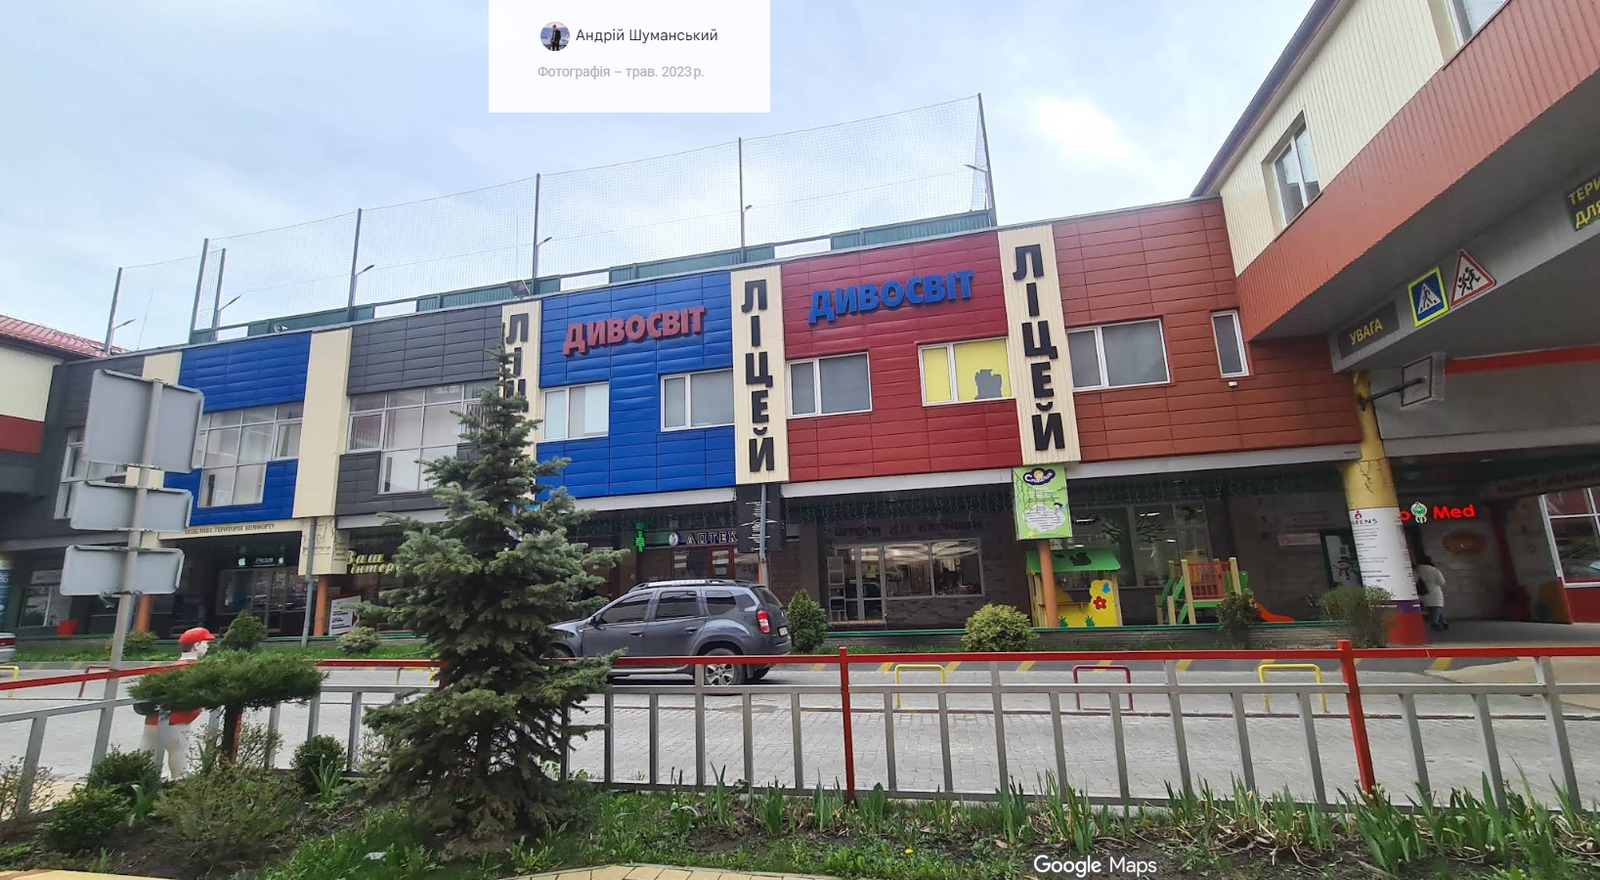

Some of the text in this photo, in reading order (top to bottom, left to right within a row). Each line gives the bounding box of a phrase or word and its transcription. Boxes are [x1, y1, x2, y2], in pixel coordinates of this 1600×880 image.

[808, 269, 976, 325] ДИВОСВІТ
[563, 305, 707, 357] ДИВОСВІТ
[1012, 243, 1066, 452] ЛІЦЕЙ
[1349, 318, 1383, 346] УВАГА
[741, 279, 775, 473] ЛІЦЕЙ
[1432, 503, 1476, 519] Med
